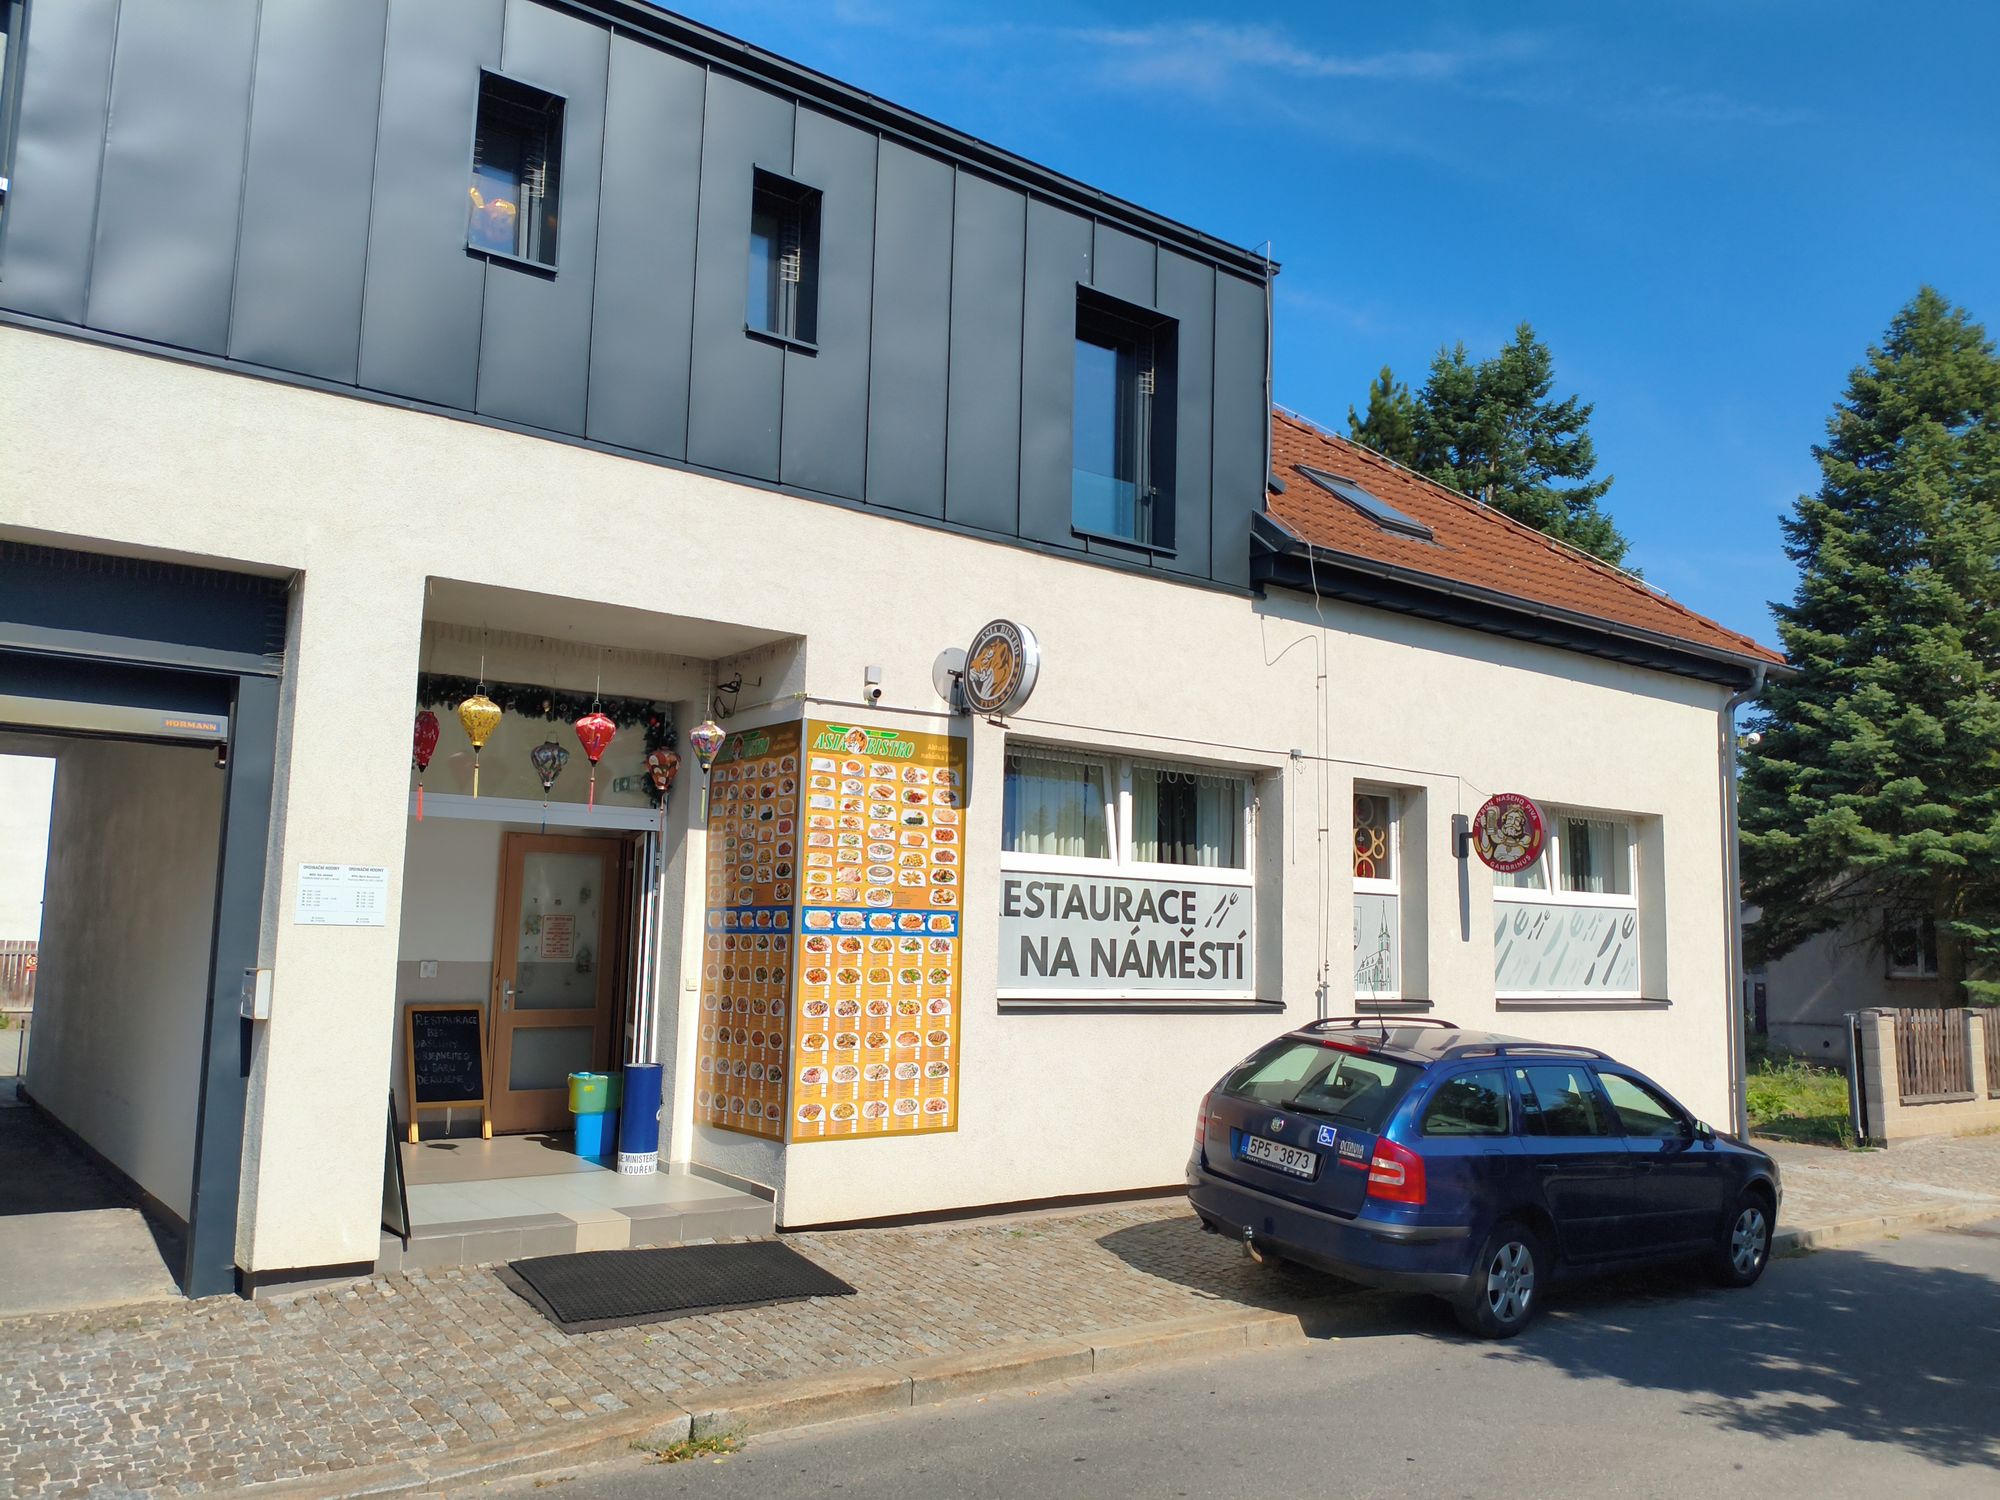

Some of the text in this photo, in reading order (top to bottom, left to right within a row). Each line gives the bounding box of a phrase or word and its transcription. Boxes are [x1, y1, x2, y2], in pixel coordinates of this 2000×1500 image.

[981, 625, 1020, 655] ASIA BISTRO
[812, 731, 847, 752] ASIA
[863, 736, 915, 759] BISTRO
[1474, 794, 1538, 827] PATRON NAŠEHO PIVA
[1489, 855, 1531, 871] GAMBRINUS
[999, 879, 1196, 925] ESTAURACE
[1020, 925, 1247, 980] NA NÁMĚSTÍ
[1250, 1138, 1272, 1158] 5P5
[1279, 1147, 1310, 1170] 3873
